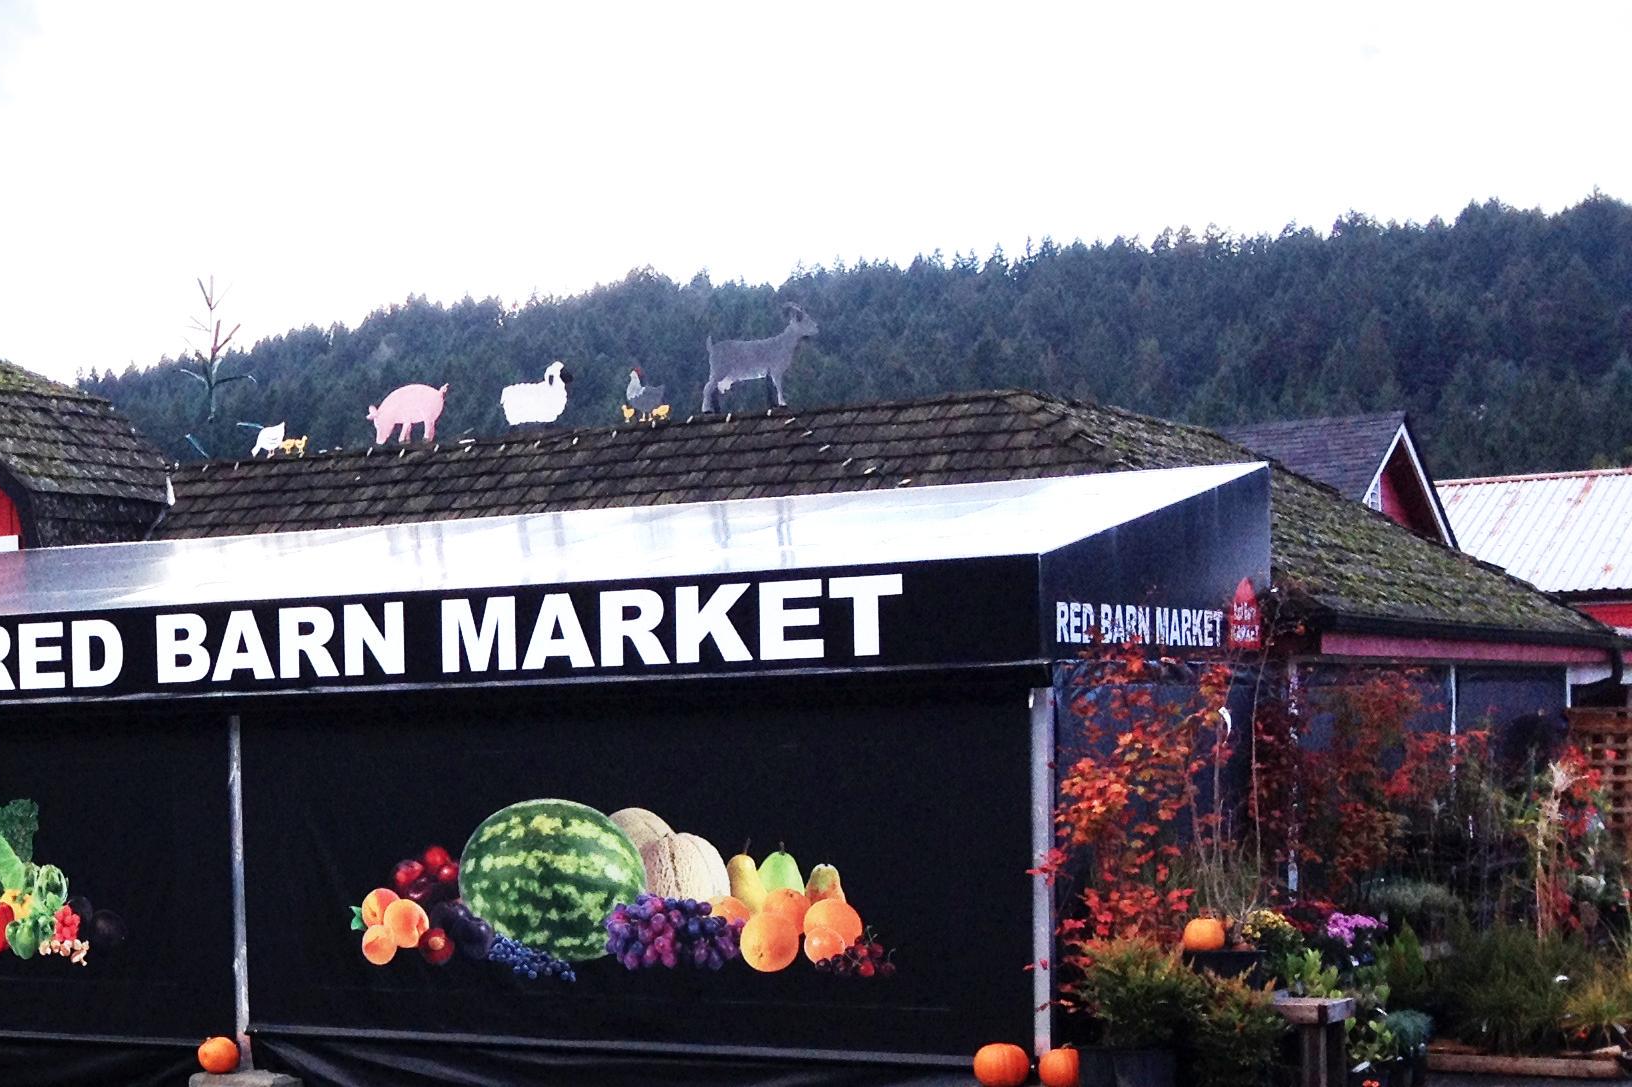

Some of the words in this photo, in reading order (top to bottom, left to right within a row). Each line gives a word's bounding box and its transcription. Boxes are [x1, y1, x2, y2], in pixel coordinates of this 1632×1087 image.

[155, 600, 408, 685] BARN
[440, 572, 904, 673] MARKET
[1056, 601, 1095, 644] RED
[1100, 603, 1151, 645] BARN
[1155, 606, 1224, 647] MARKET
